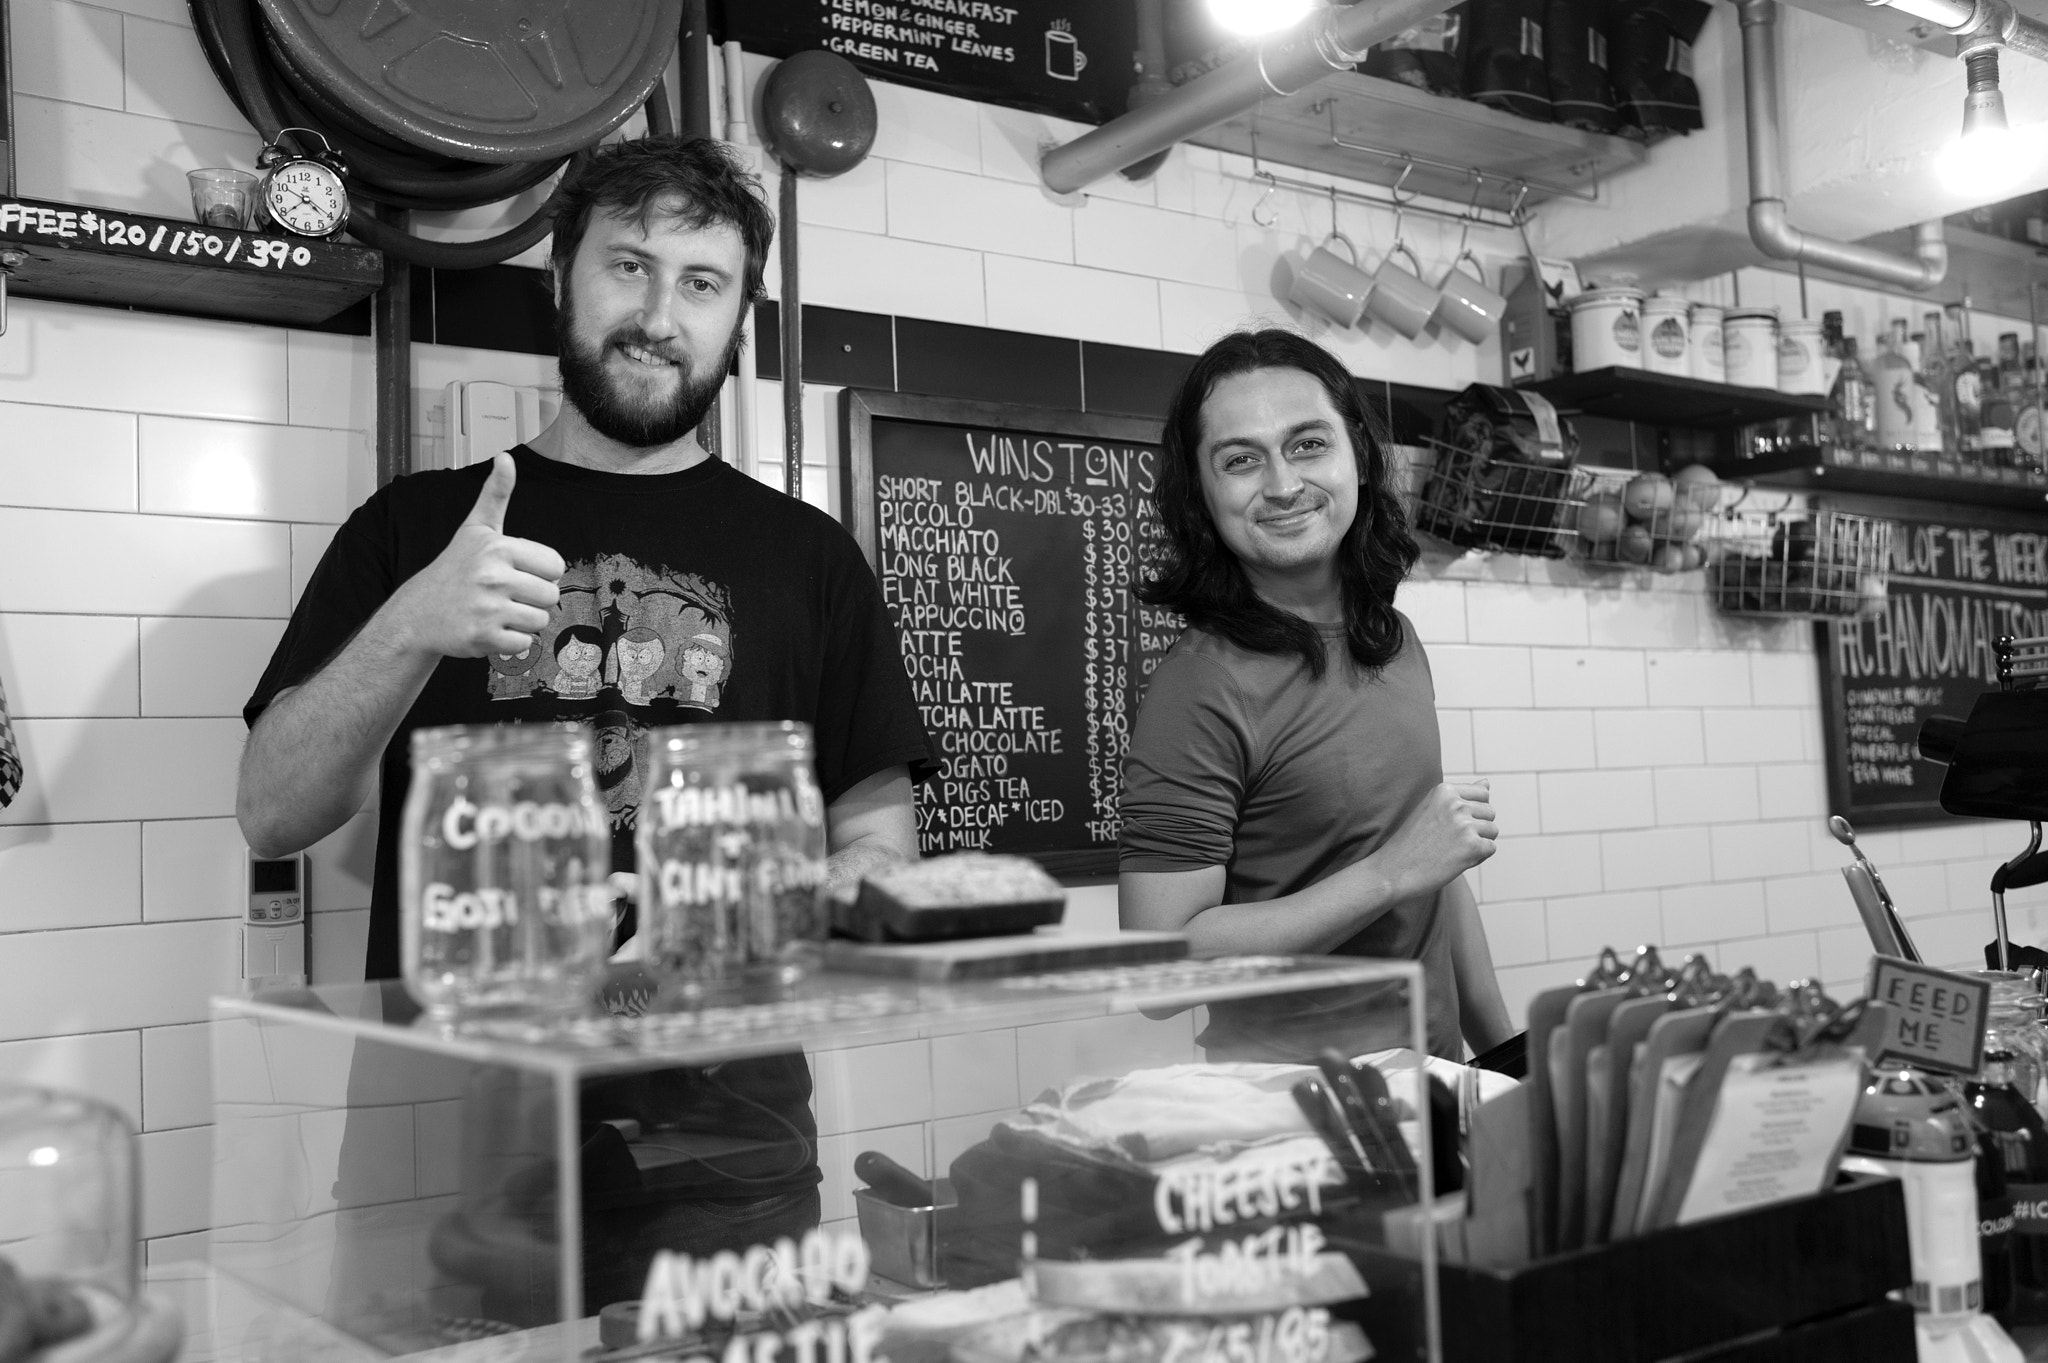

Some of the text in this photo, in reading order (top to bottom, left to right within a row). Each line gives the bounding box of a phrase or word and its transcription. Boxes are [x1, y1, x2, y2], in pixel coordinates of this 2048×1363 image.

[830, 37, 939, 72] GREEN TEA
[951, 37, 1015, 62] LEAVES
[277, 183, 289, 192] 10
[287, 174, 297, 183] 11
[299, 172, 311, 182] 12
[316, 177, 321, 186] 1
[275, 194, 283, 204] 9
[325, 187, 332, 196] 2
[280, 207, 287, 217] 8
[330, 199, 337, 209] 3
[290, 217, 297, 226] 7
[304, 221, 311, 231] 6
[318, 220, 324, 229] 5
[327, 211, 334, 221] 4
[967, 433, 1154, 493] WINSTON'S
[877, 475, 942, 502] SHORT
[880, 502, 973, 528] PICCOLO
[881, 526, 999, 555] MACCHIATO
[1914, 525, 1946, 577] OF
[1947, 528, 1993, 580] THE
[881, 551, 938, 578] LONG
[948, 555, 1014, 583] BLACK
[882, 577, 940, 605] FLAT
[949, 582, 1024, 609] WHITE
[948, 682, 1013, 705] LATTE
[979, 706, 1044, 730] LATTE
[942, 729, 1064, 753] CHOCOLATE
[944, 780, 990, 804] PIGS
[994, 777, 1030, 799] TEA
[917, 831, 944, 852] IM
[949, 829, 992, 849] MILK
[1887, 977, 1971, 1016] FEED
[1899, 1017, 1941, 1044] ME
